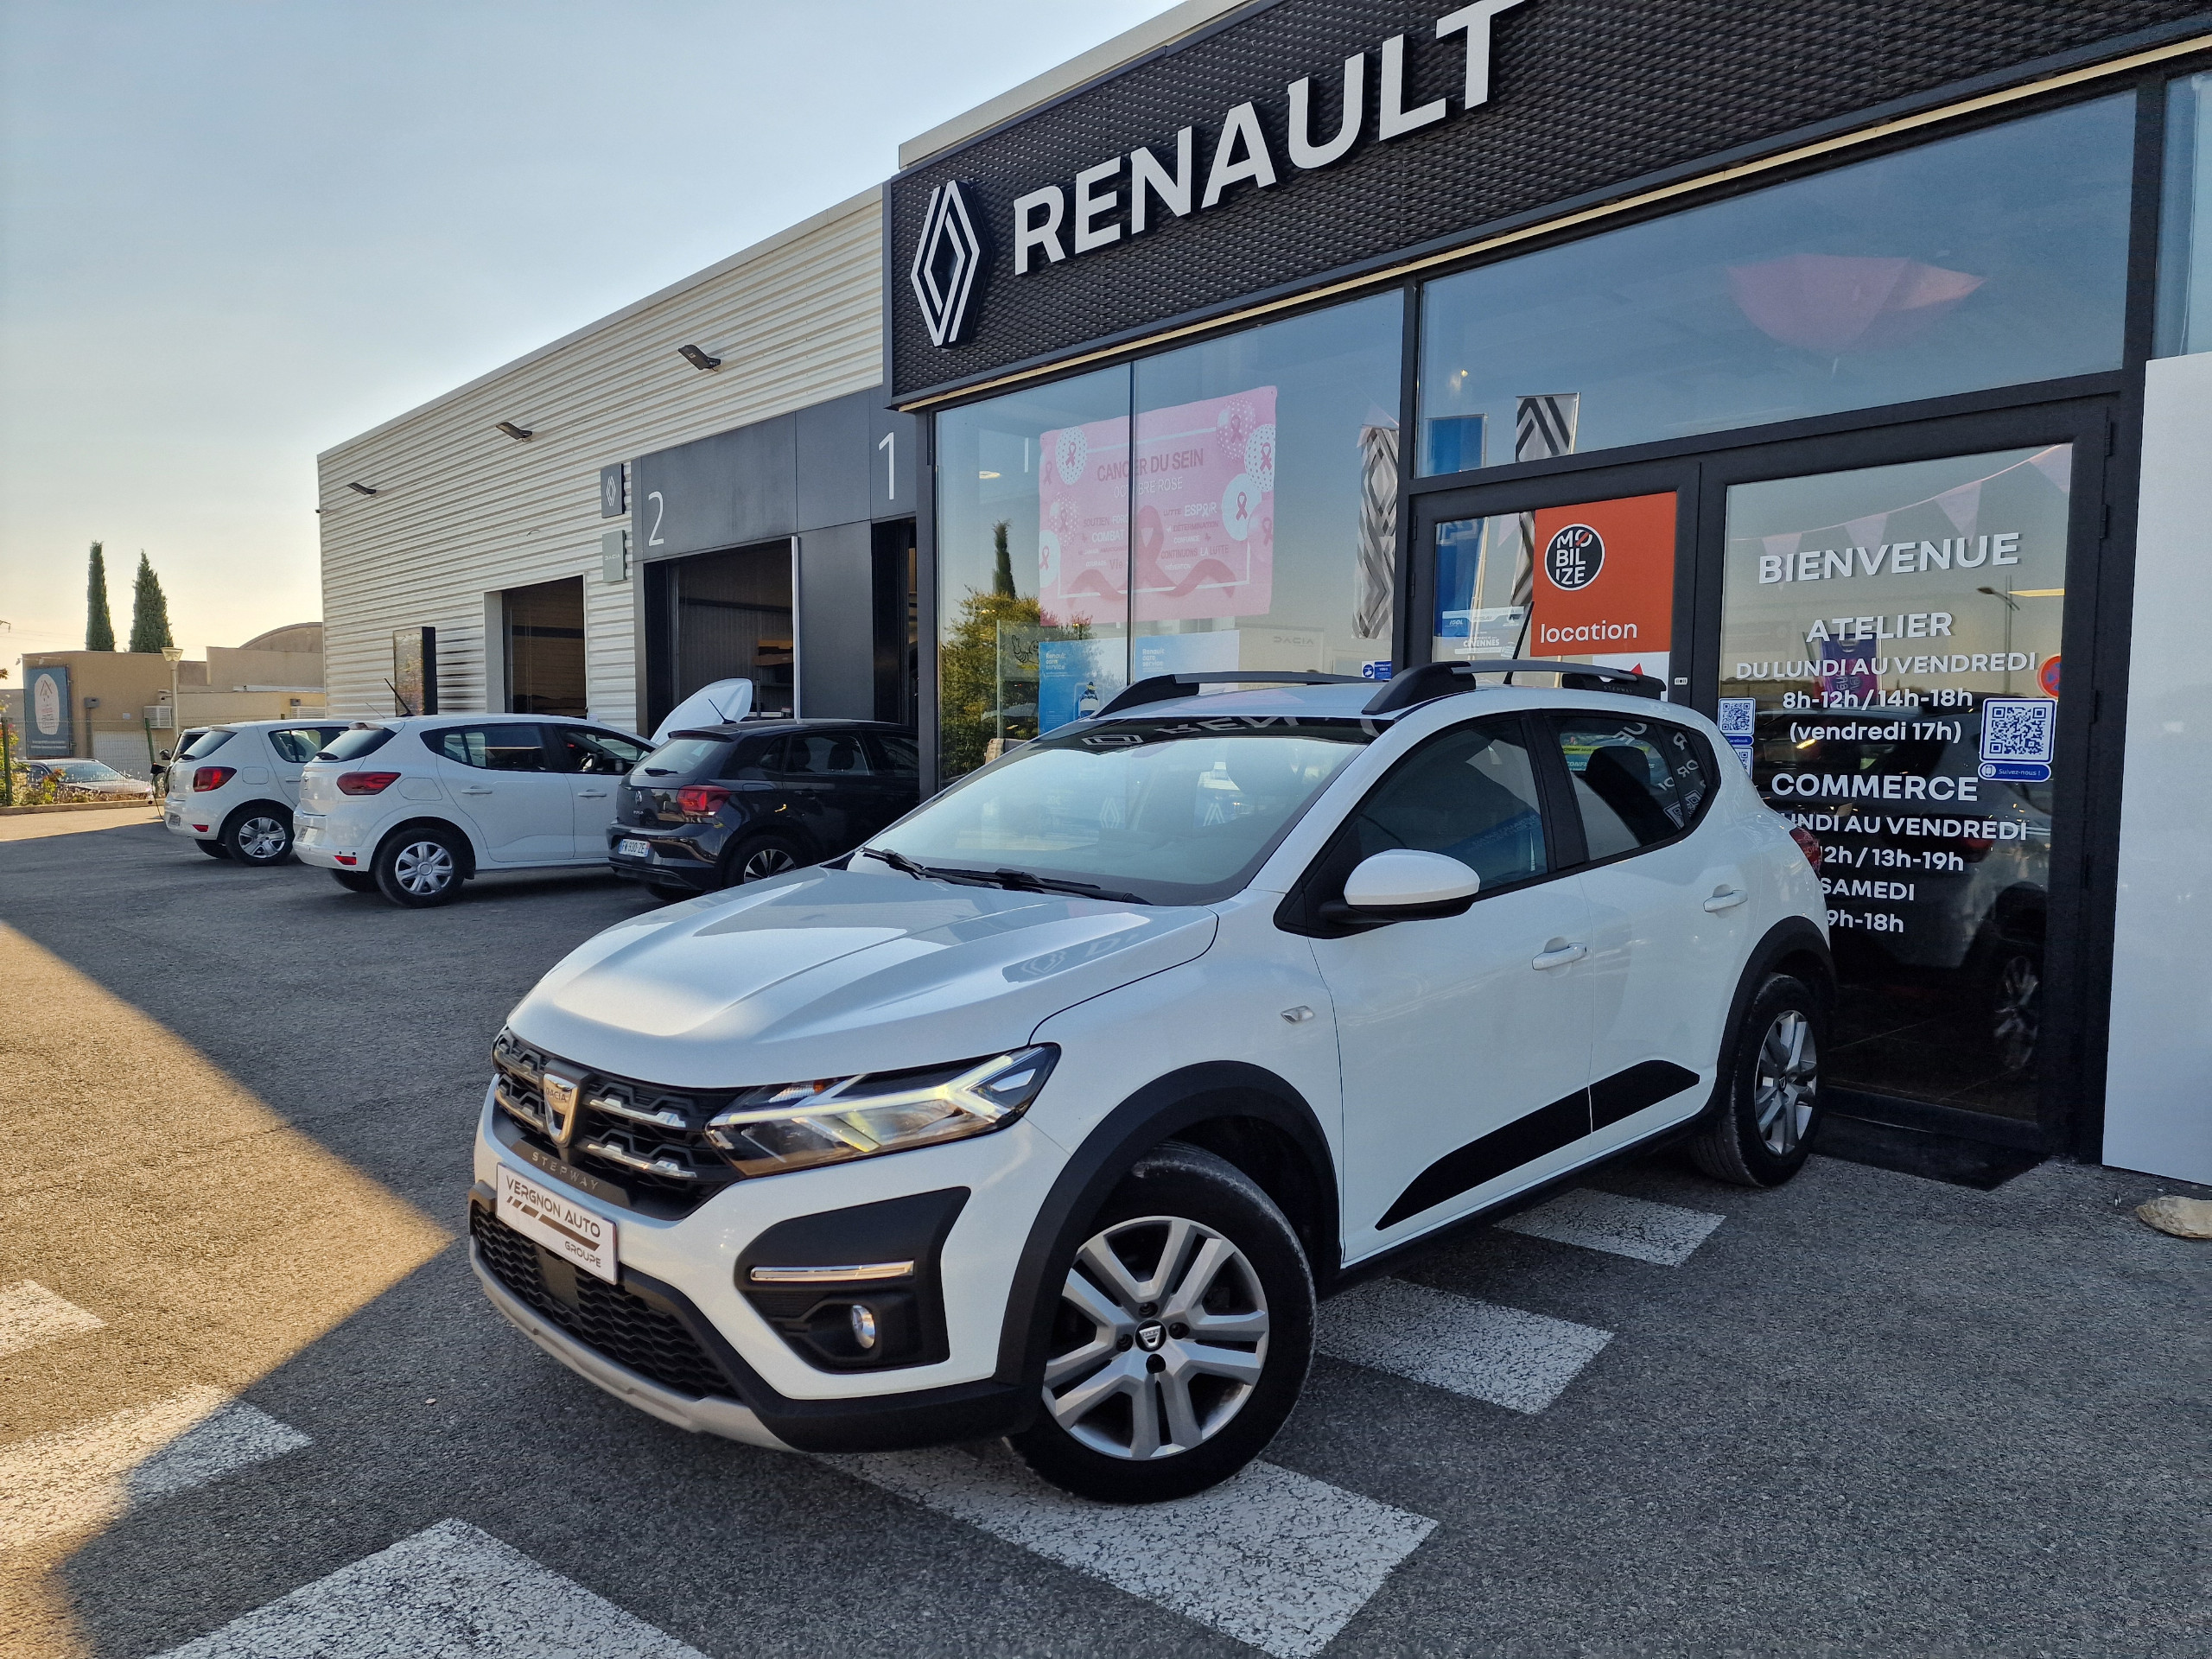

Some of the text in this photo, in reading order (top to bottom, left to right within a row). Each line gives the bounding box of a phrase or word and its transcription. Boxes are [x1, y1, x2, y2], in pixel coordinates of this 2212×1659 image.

[1014, 0, 1526, 276] RENAULT
[877, 431, 896, 501] 1
[1096, 448, 1204, 482] CANCER DU SEIN
[1114, 476, 1183, 499] OCTBRE ROSE
[648, 491, 664, 547] 2
[1091, 529, 1125, 543] COMBAT
[1200, 547, 1209, 557] LA
[1210, 544, 1230, 556] LUTTE
[1555, 548, 1586, 567] BIL
[1758, 532, 2020, 584] BIENVENUE
[1555, 566, 1586, 585] IZE
[1540, 620, 1637, 644] location
[1805, 612, 1953, 643] ATELIER
[1736, 652, 2037, 680] DU LUNDI AU VENDREDI
[1783, 690, 1859, 709] 8h-12h
[1878, 689, 1973, 709] 14h-18h
[1789, 721, 1962, 744] (vendredi 17h)
[1771, 772, 1980, 802] COMMERCE
[1781, 812, 2027, 841] NDI AU VENDREDI
[1872, 849, 1964, 872] 13h-19h
[1821, 877, 1915, 901] SAMEDI
[1826, 909, 1904, 933] 9h-18h
[545, 1086, 568, 1103] DACIA
[531, 1151, 599, 1191] STEPWAY
[505, 1174, 601, 1238] VERGNON AUTO
[564, 1240, 602, 1268] GROUPE
